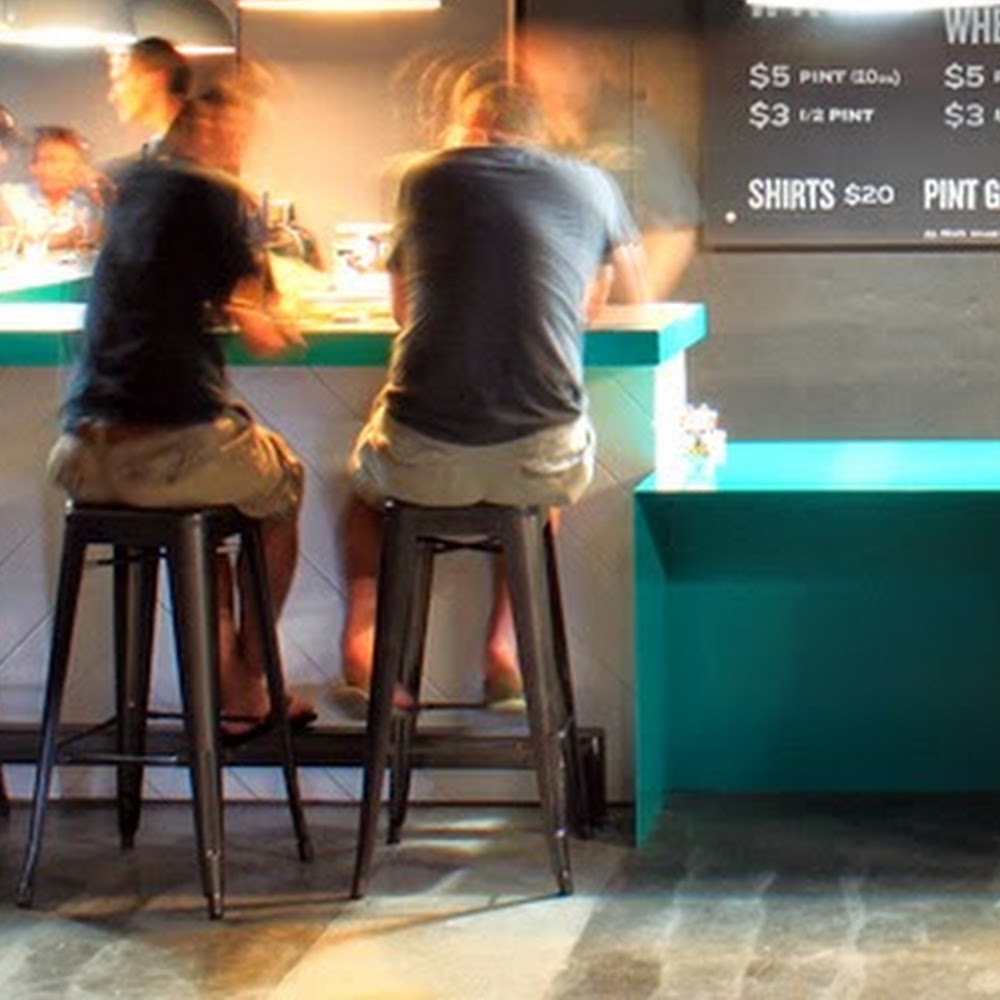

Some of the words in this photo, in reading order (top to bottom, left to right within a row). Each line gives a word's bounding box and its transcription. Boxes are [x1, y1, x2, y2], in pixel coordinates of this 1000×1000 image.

[749, 62, 791, 91] $5
[800, 69, 846, 85] PINT
[944, 62, 985, 91] $5
[749, 100, 790, 130] $3
[829, 108, 875, 122] PINT
[944, 100, 985, 130] $3
[748, 177, 836, 211] SHIRTS
[844, 182, 895, 207] $20
[923, 177, 980, 211] PINT
